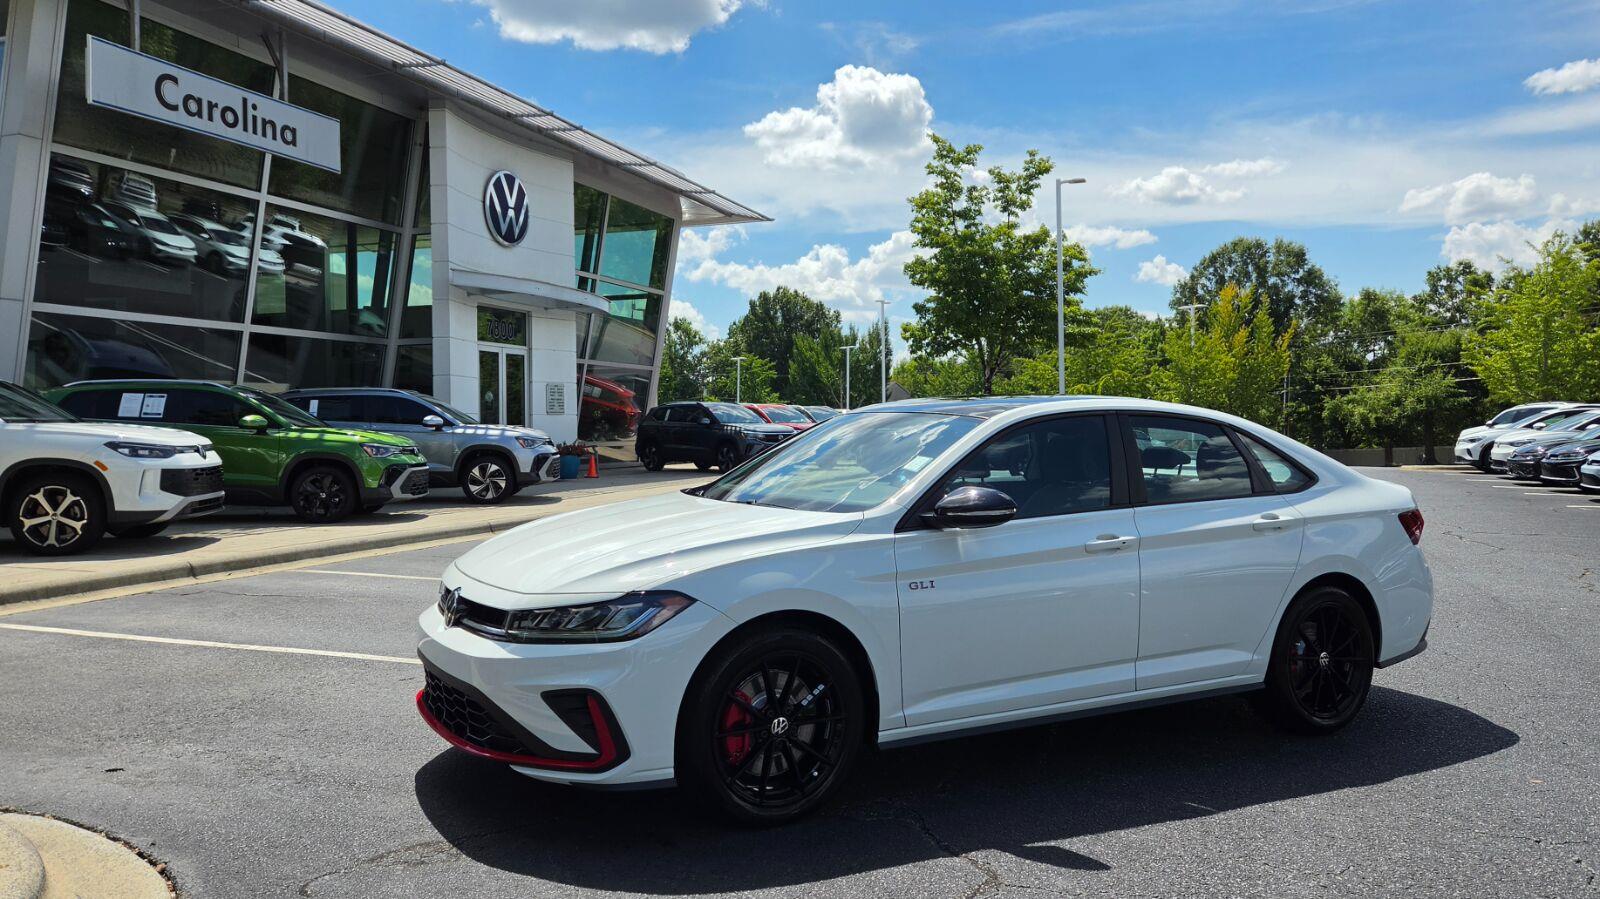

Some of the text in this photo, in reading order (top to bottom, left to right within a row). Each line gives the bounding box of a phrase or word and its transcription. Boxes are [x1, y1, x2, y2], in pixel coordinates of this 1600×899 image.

[154, 73, 298, 147] Carolina
[484, 170, 529, 247] VW
[486, 319, 515, 340] 7800
[908, 580, 936, 590] GLI
